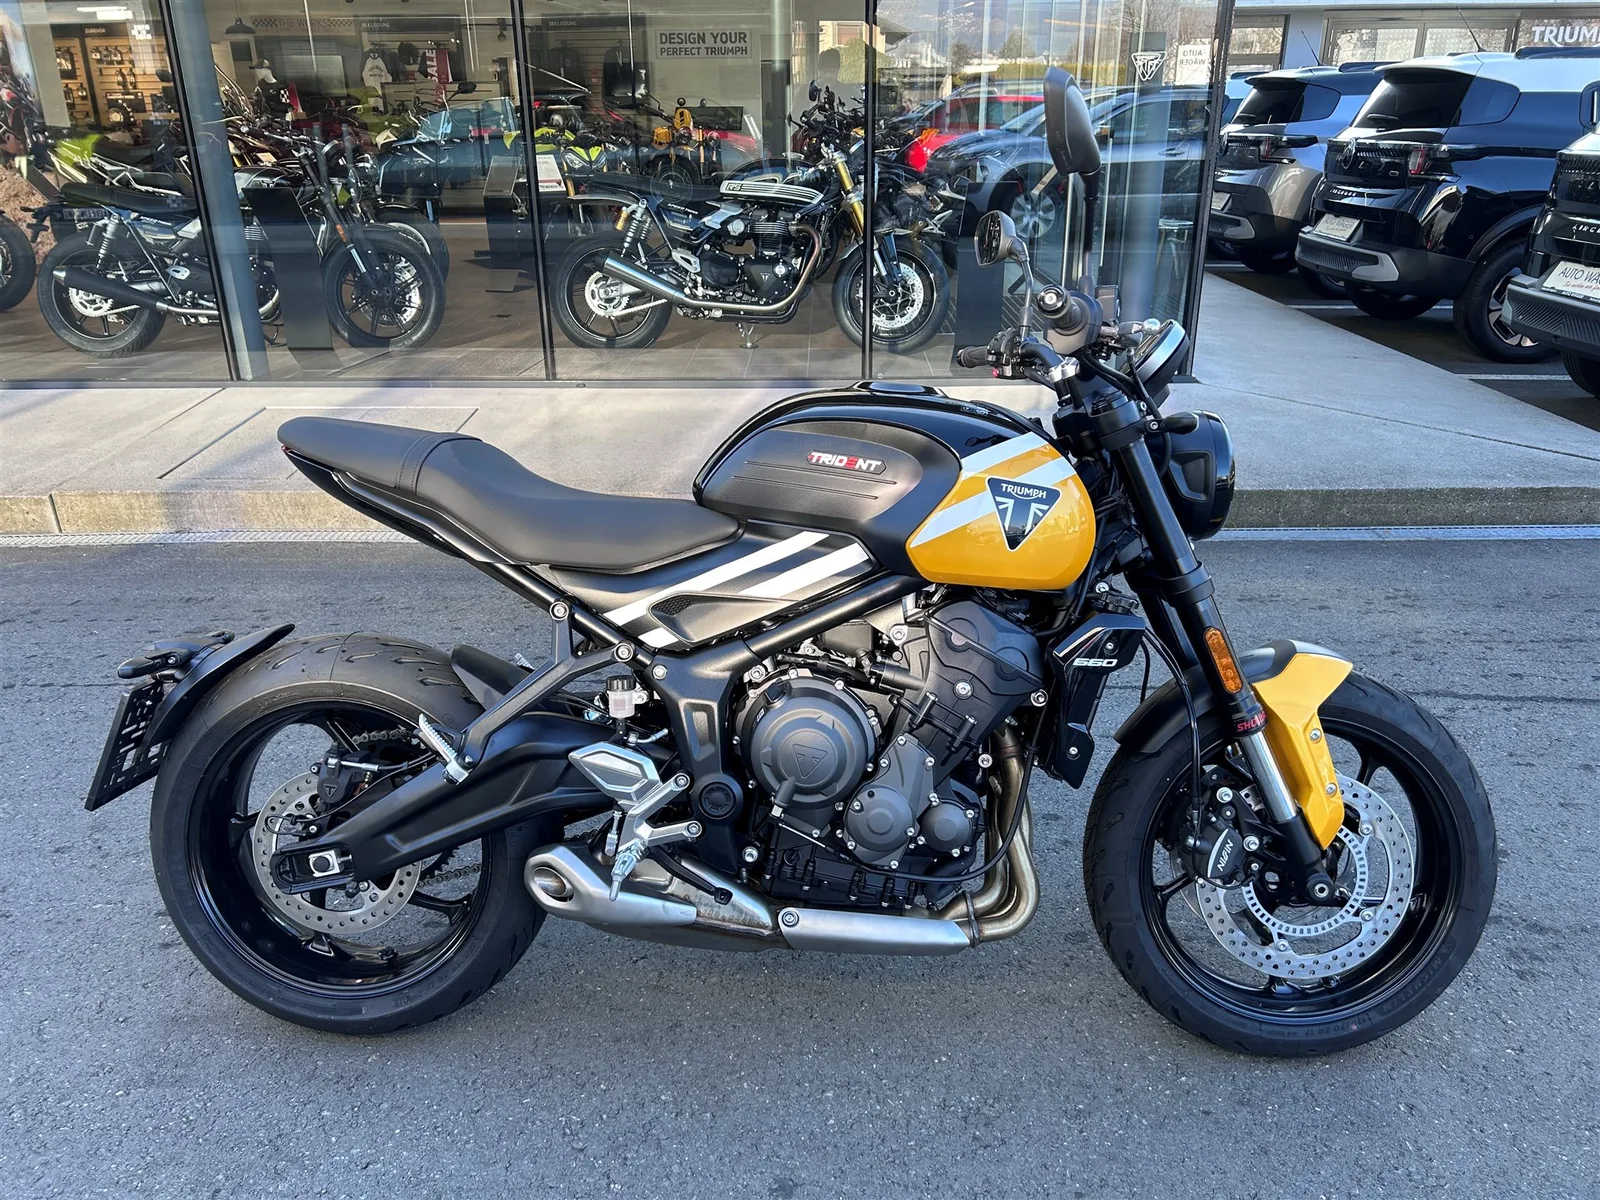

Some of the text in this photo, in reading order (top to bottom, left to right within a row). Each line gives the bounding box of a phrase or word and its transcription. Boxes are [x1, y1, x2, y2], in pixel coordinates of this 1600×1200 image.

[659, 32, 748, 45] DESIGN YOUR
[1532, 26, 1600, 46] TRIUM
[660, 46, 748, 56] PERFECT TRIUMPH
[727, 183, 741, 191] RS
[1558, 266, 1584, 281] AUTO
[810, 451, 882, 472] TRIDENT
[1001, 483, 1047, 499] TRIUMPH
[1073, 658, 1118, 667] 660
[1217, 838, 1234, 872] NISSIN
